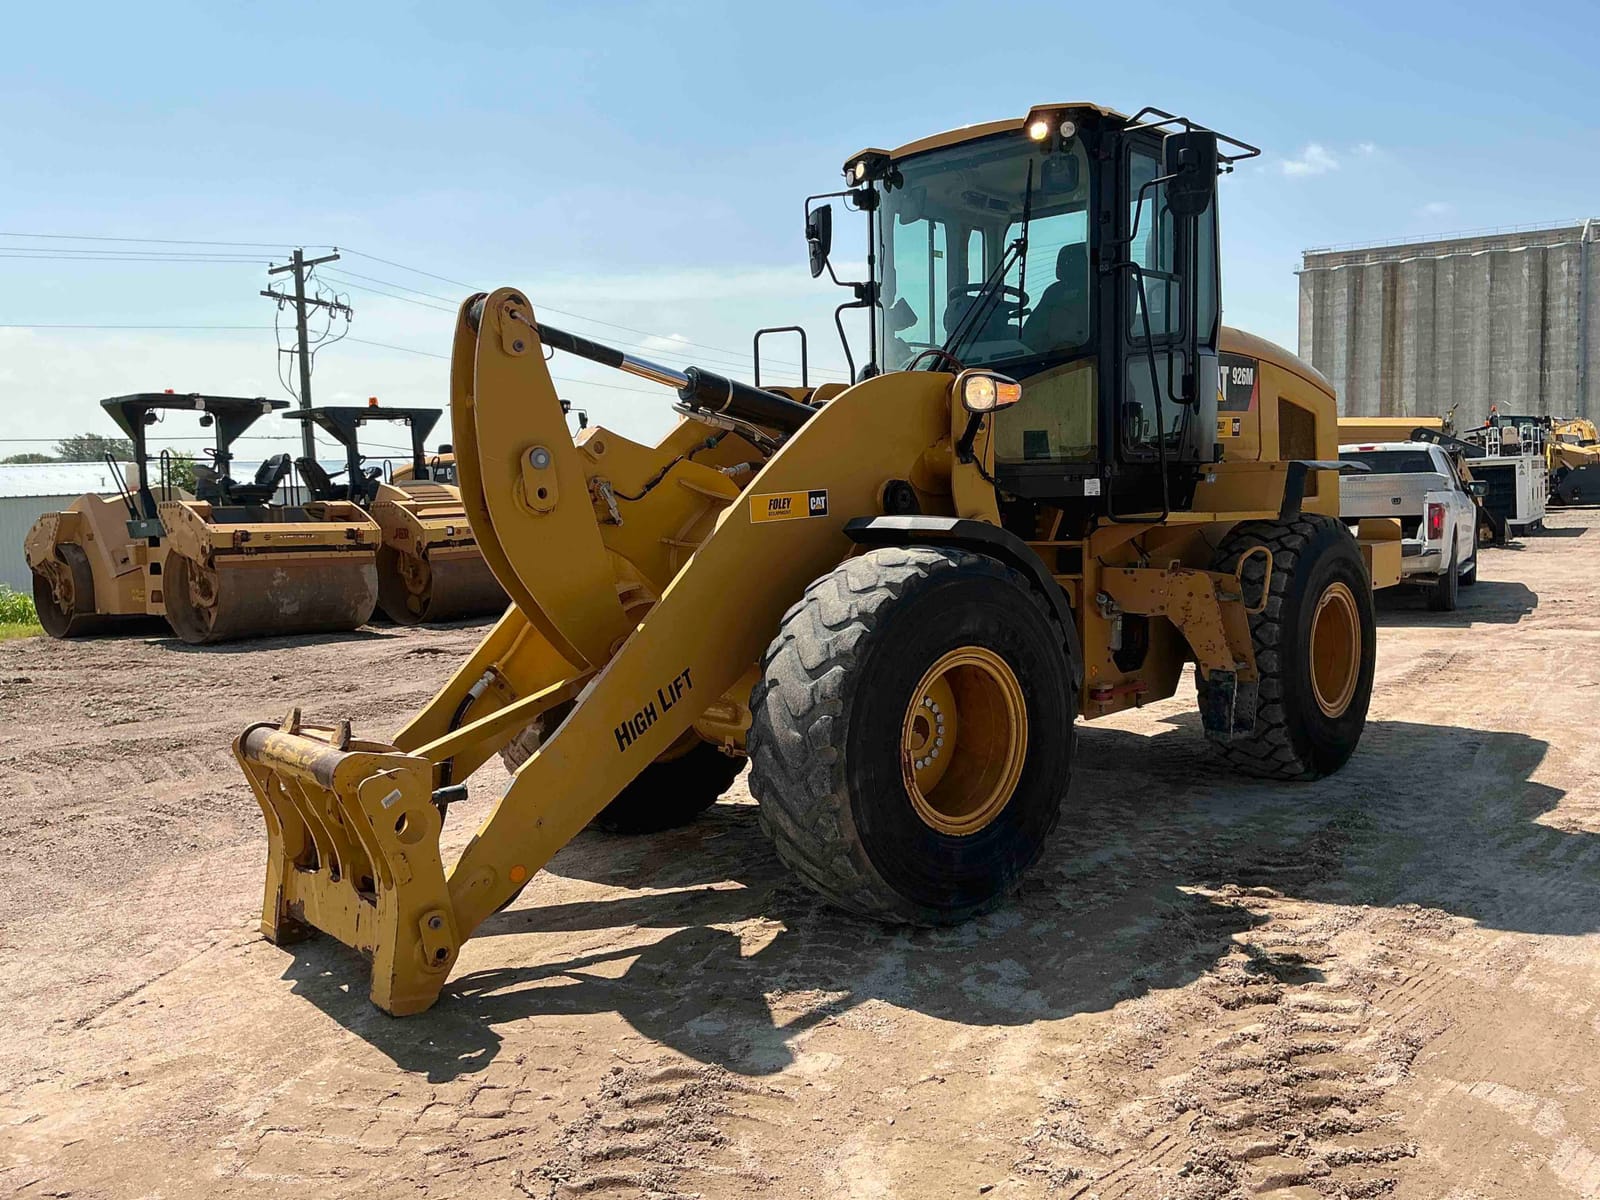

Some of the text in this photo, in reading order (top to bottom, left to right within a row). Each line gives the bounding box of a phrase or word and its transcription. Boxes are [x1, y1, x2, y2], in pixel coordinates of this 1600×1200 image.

[1217, 366, 1253, 401] T 926M
[768, 497, 825, 510] FOLEY CAT
[614, 667, 692, 753] HIGH LIFT
